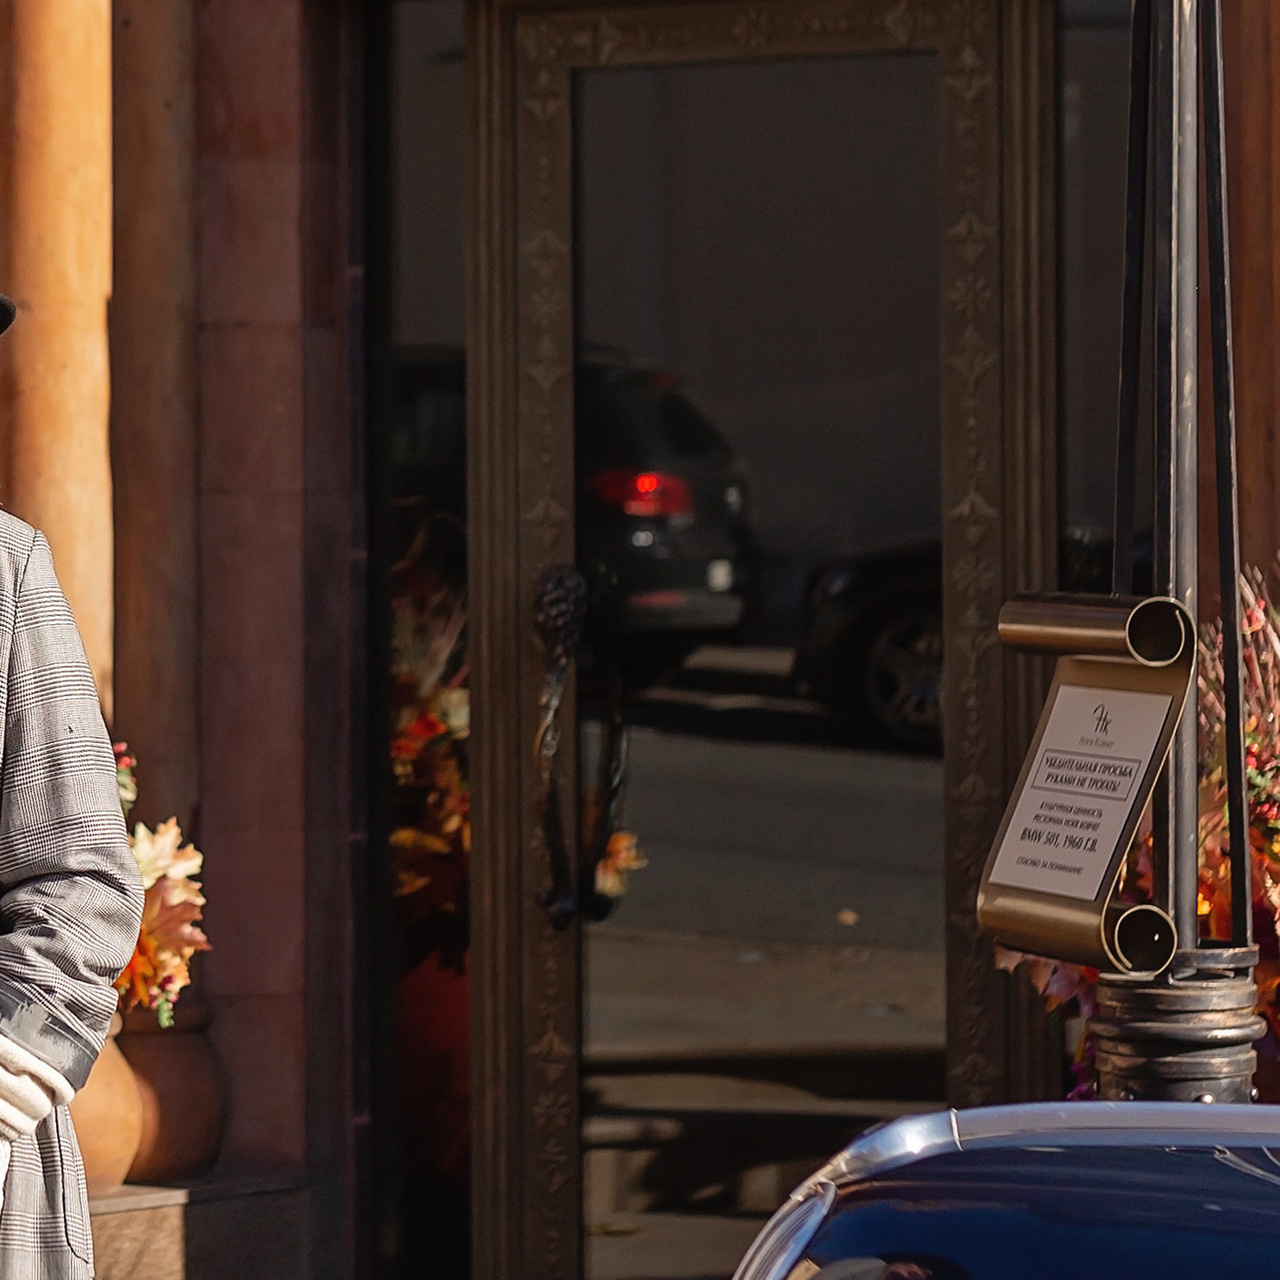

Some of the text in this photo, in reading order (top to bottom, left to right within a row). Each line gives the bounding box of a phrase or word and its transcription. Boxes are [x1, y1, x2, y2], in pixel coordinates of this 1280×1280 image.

[1045, 756, 1133, 778] УБЕДИТЕЛЬНАЯ ПРОСЬБА
[1045, 772, 1077, 786] РУКАМИ
[1076, 776, 1088, 788] НЕ
[1020, 827, 1045, 844] BMW
[1042, 831, 1060, 848] 501,
[1062, 834, 1084, 850] 1960
